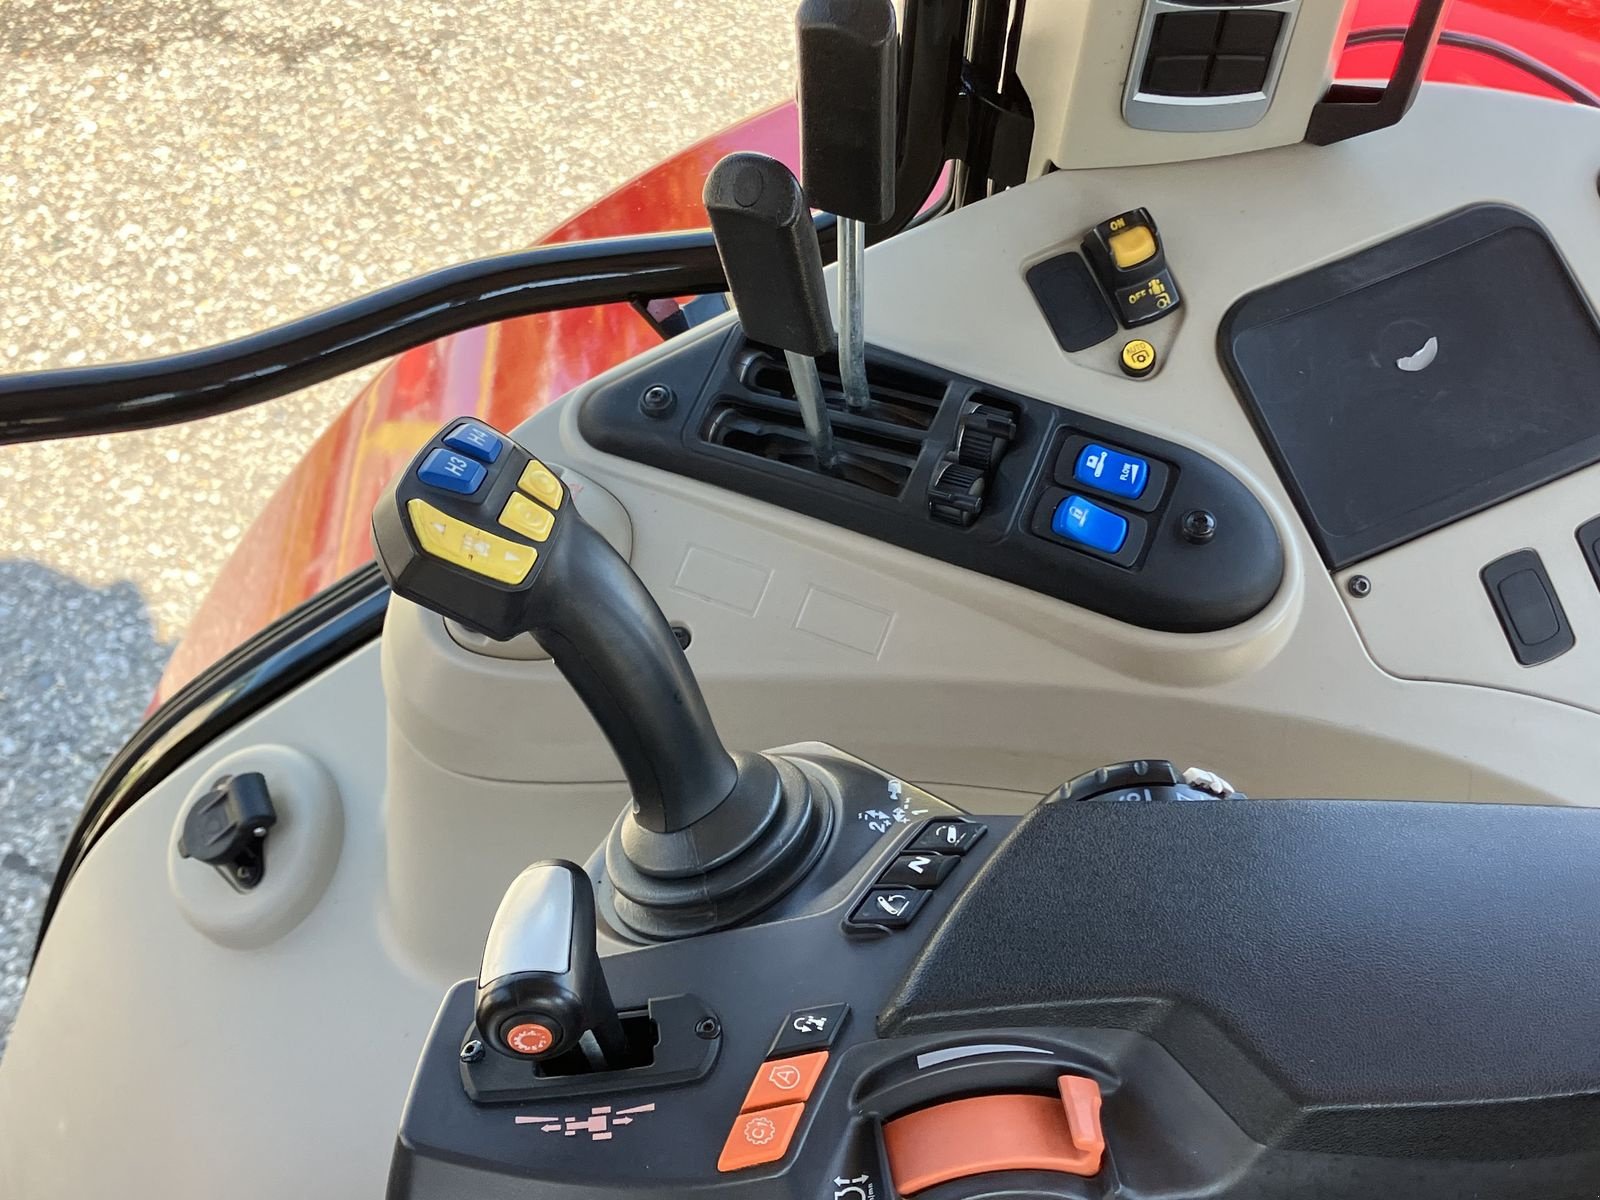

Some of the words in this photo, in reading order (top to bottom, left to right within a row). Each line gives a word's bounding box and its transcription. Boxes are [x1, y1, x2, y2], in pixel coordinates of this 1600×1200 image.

[1109, 218, 1126, 231] ON
[1128, 289, 1147, 305] OFF
[1126, 343, 1146, 355] AUTO
[467, 427, 488, 446] H4
[445, 456, 468, 477] H3
[1119, 463, 1132, 481] FLOW
[868, 821, 886, 833] 2
[908, 855, 932, 875] N
